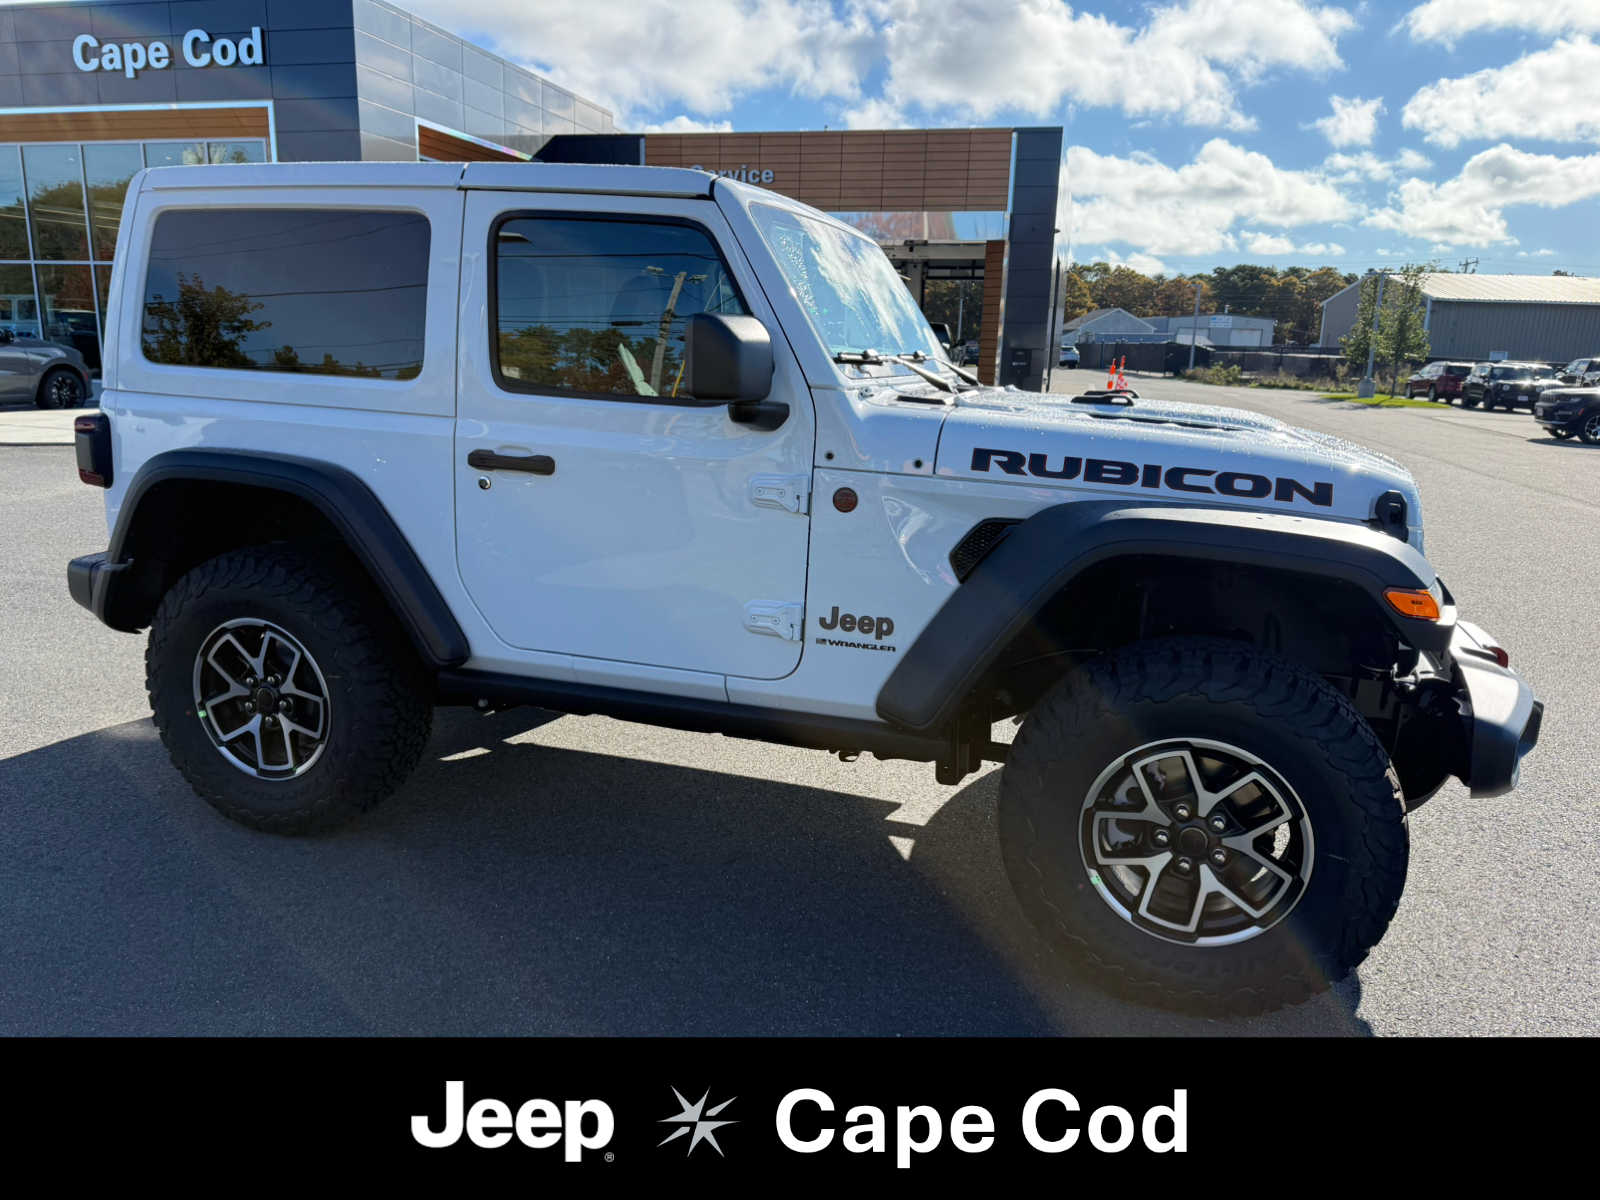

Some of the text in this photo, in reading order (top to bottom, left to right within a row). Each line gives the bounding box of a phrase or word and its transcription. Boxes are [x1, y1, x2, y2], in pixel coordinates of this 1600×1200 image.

[73, 26, 264, 78] Cape Cod
[691, 164, 775, 184] rvice
[971, 447, 1333, 507] RUBICON
[819, 606, 895, 640] Jeep
[828, 639, 897, 652] WRANGLER
